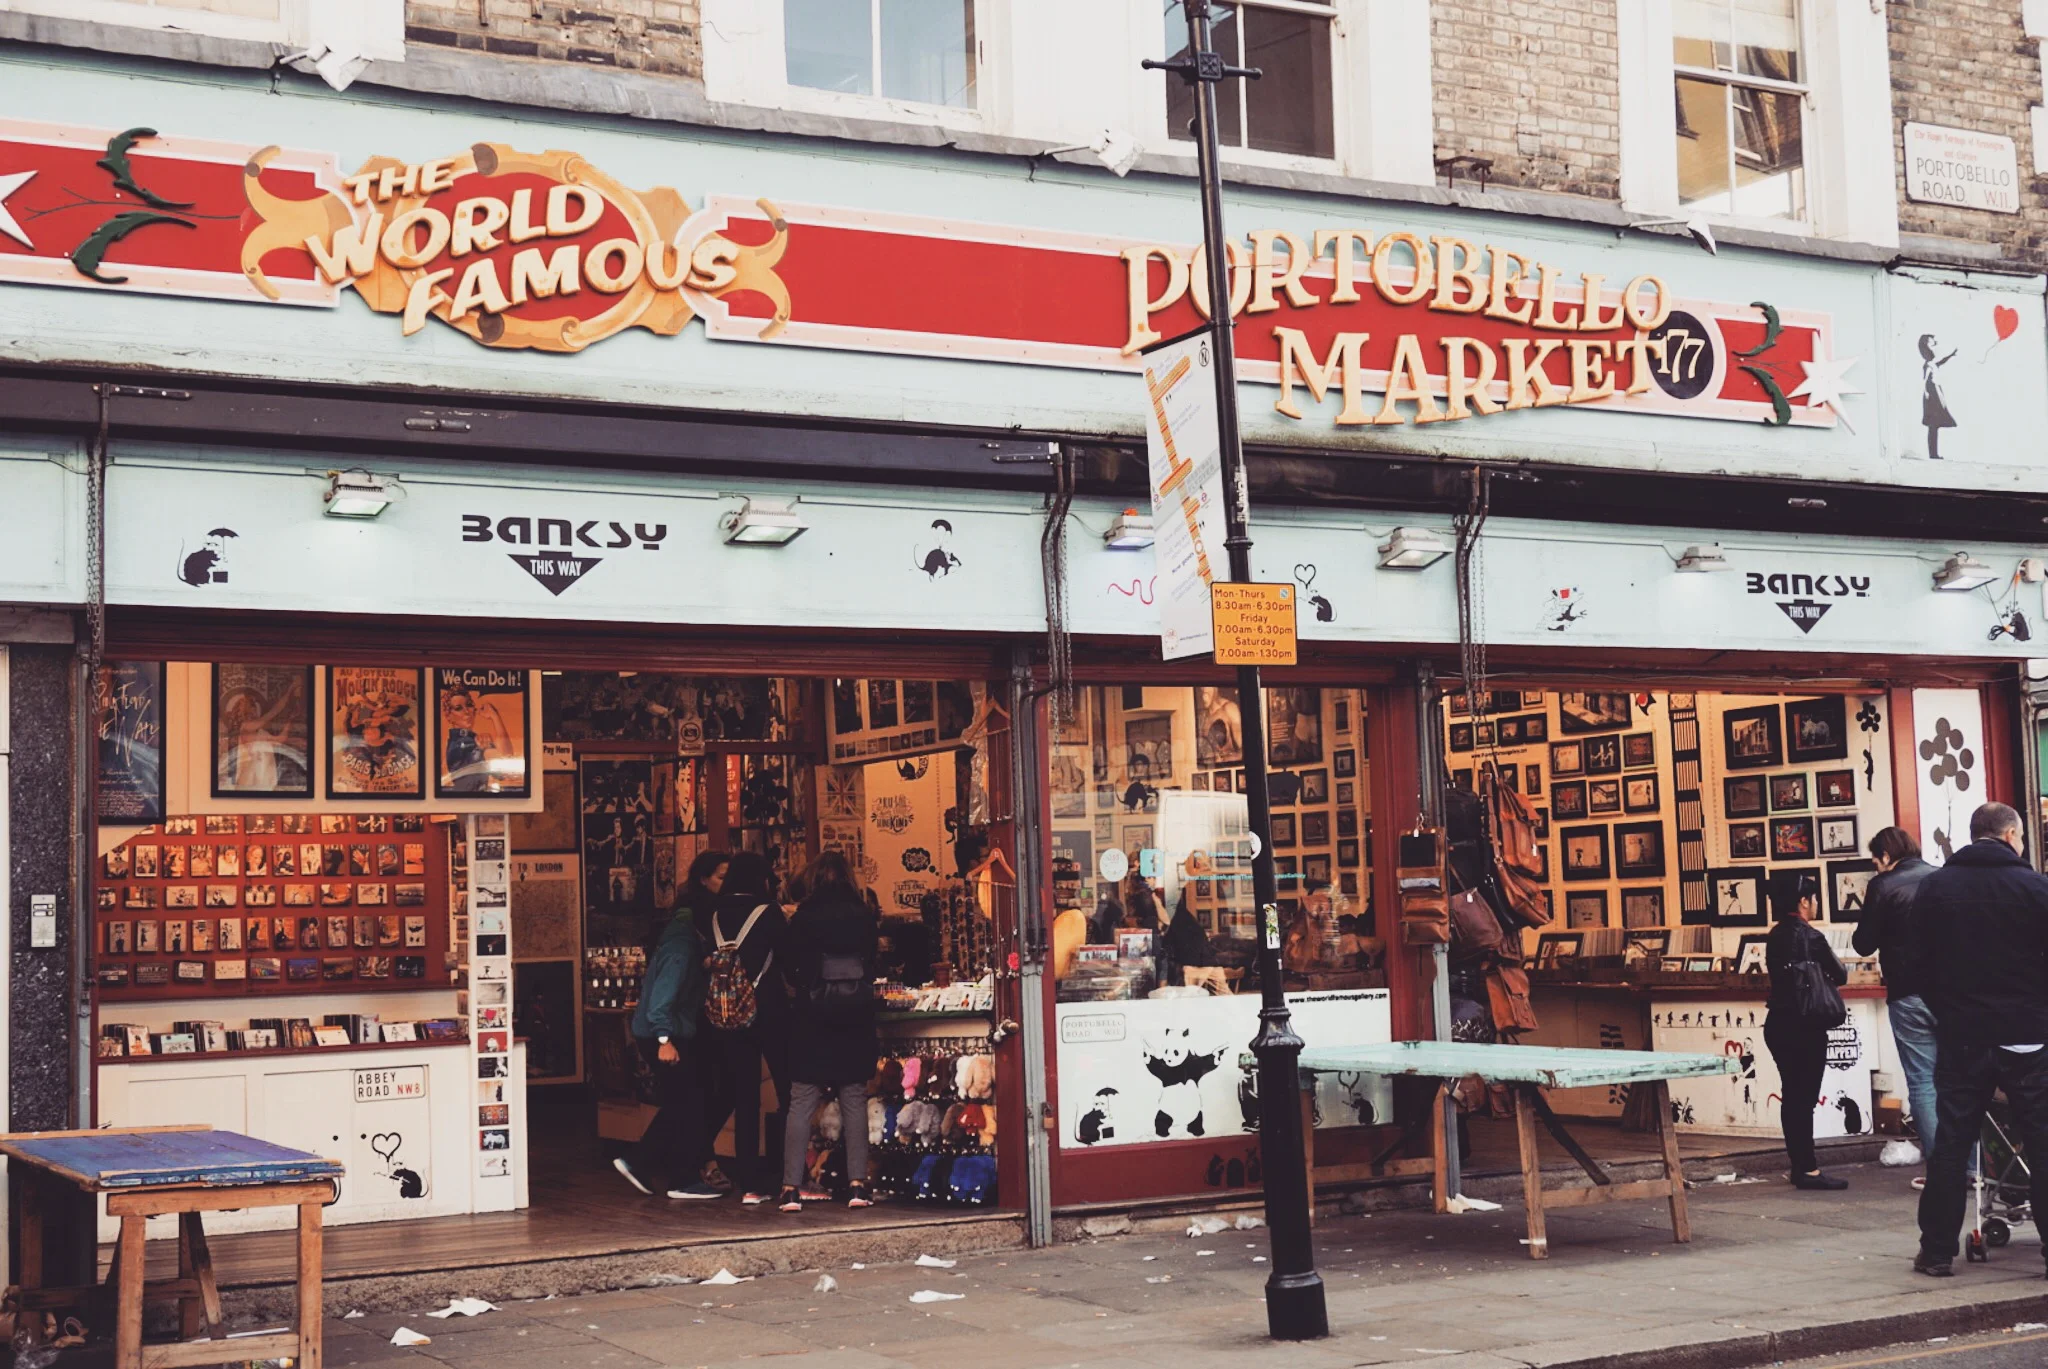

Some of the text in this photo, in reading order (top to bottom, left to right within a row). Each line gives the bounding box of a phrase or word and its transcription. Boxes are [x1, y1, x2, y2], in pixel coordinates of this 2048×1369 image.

[344, 158, 457, 204] THE
[1916, 157, 2011, 187] PORTOBELLO
[303, 184, 605, 285] WORLD
[401, 237, 741, 338] FAMOUS
[1120, 228, 1673, 356] PORTOBELLO
[1273, 325, 1664, 425] MARKET
[529, 559, 582, 577] THIS WAY
[1240, 613, 1268, 623] Friday
[1788, 605, 1804, 619] THIS
[1235, 636, 1276, 647] Saturday
[442, 668, 521, 687] We Can Do It!
[543, 744, 554, 756] Pay
[342, 753, 371, 775] PARIS
[535, 862, 564, 874] LONDON
[357, 1072, 397, 1085] ABBEY
[358, 1084, 390, 1098] ROAD
